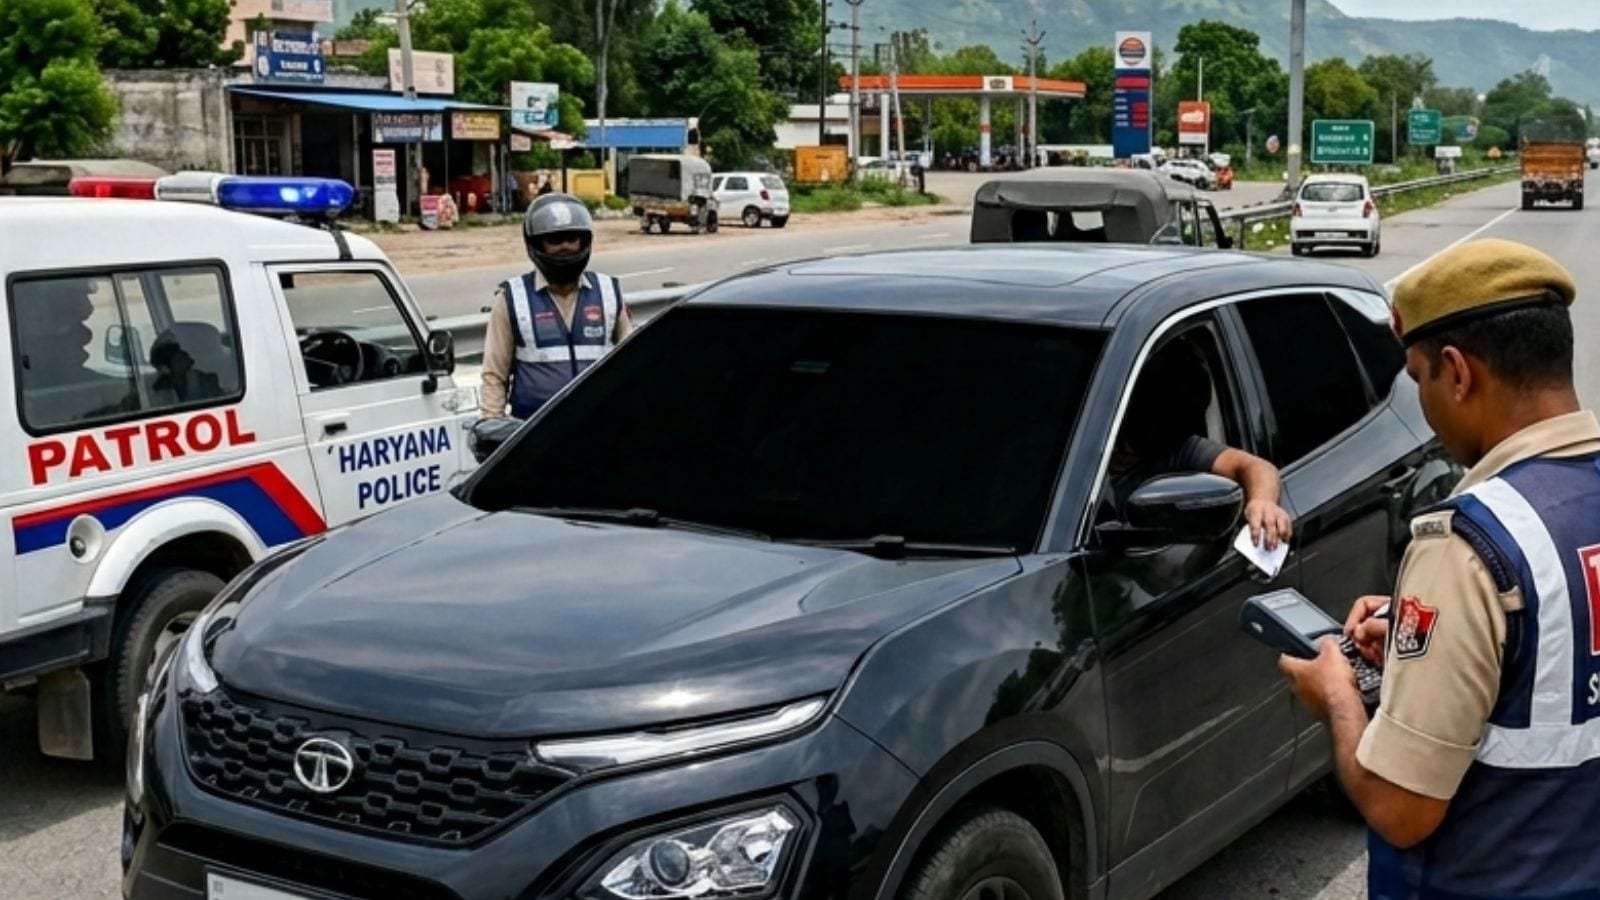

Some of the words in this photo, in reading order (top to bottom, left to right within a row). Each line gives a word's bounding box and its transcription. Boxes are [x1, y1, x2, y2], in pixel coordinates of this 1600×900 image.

[28, 409, 256, 485] PATROL
[339, 425, 451, 473] HARYANA
[358, 466, 441, 508] POLICE
